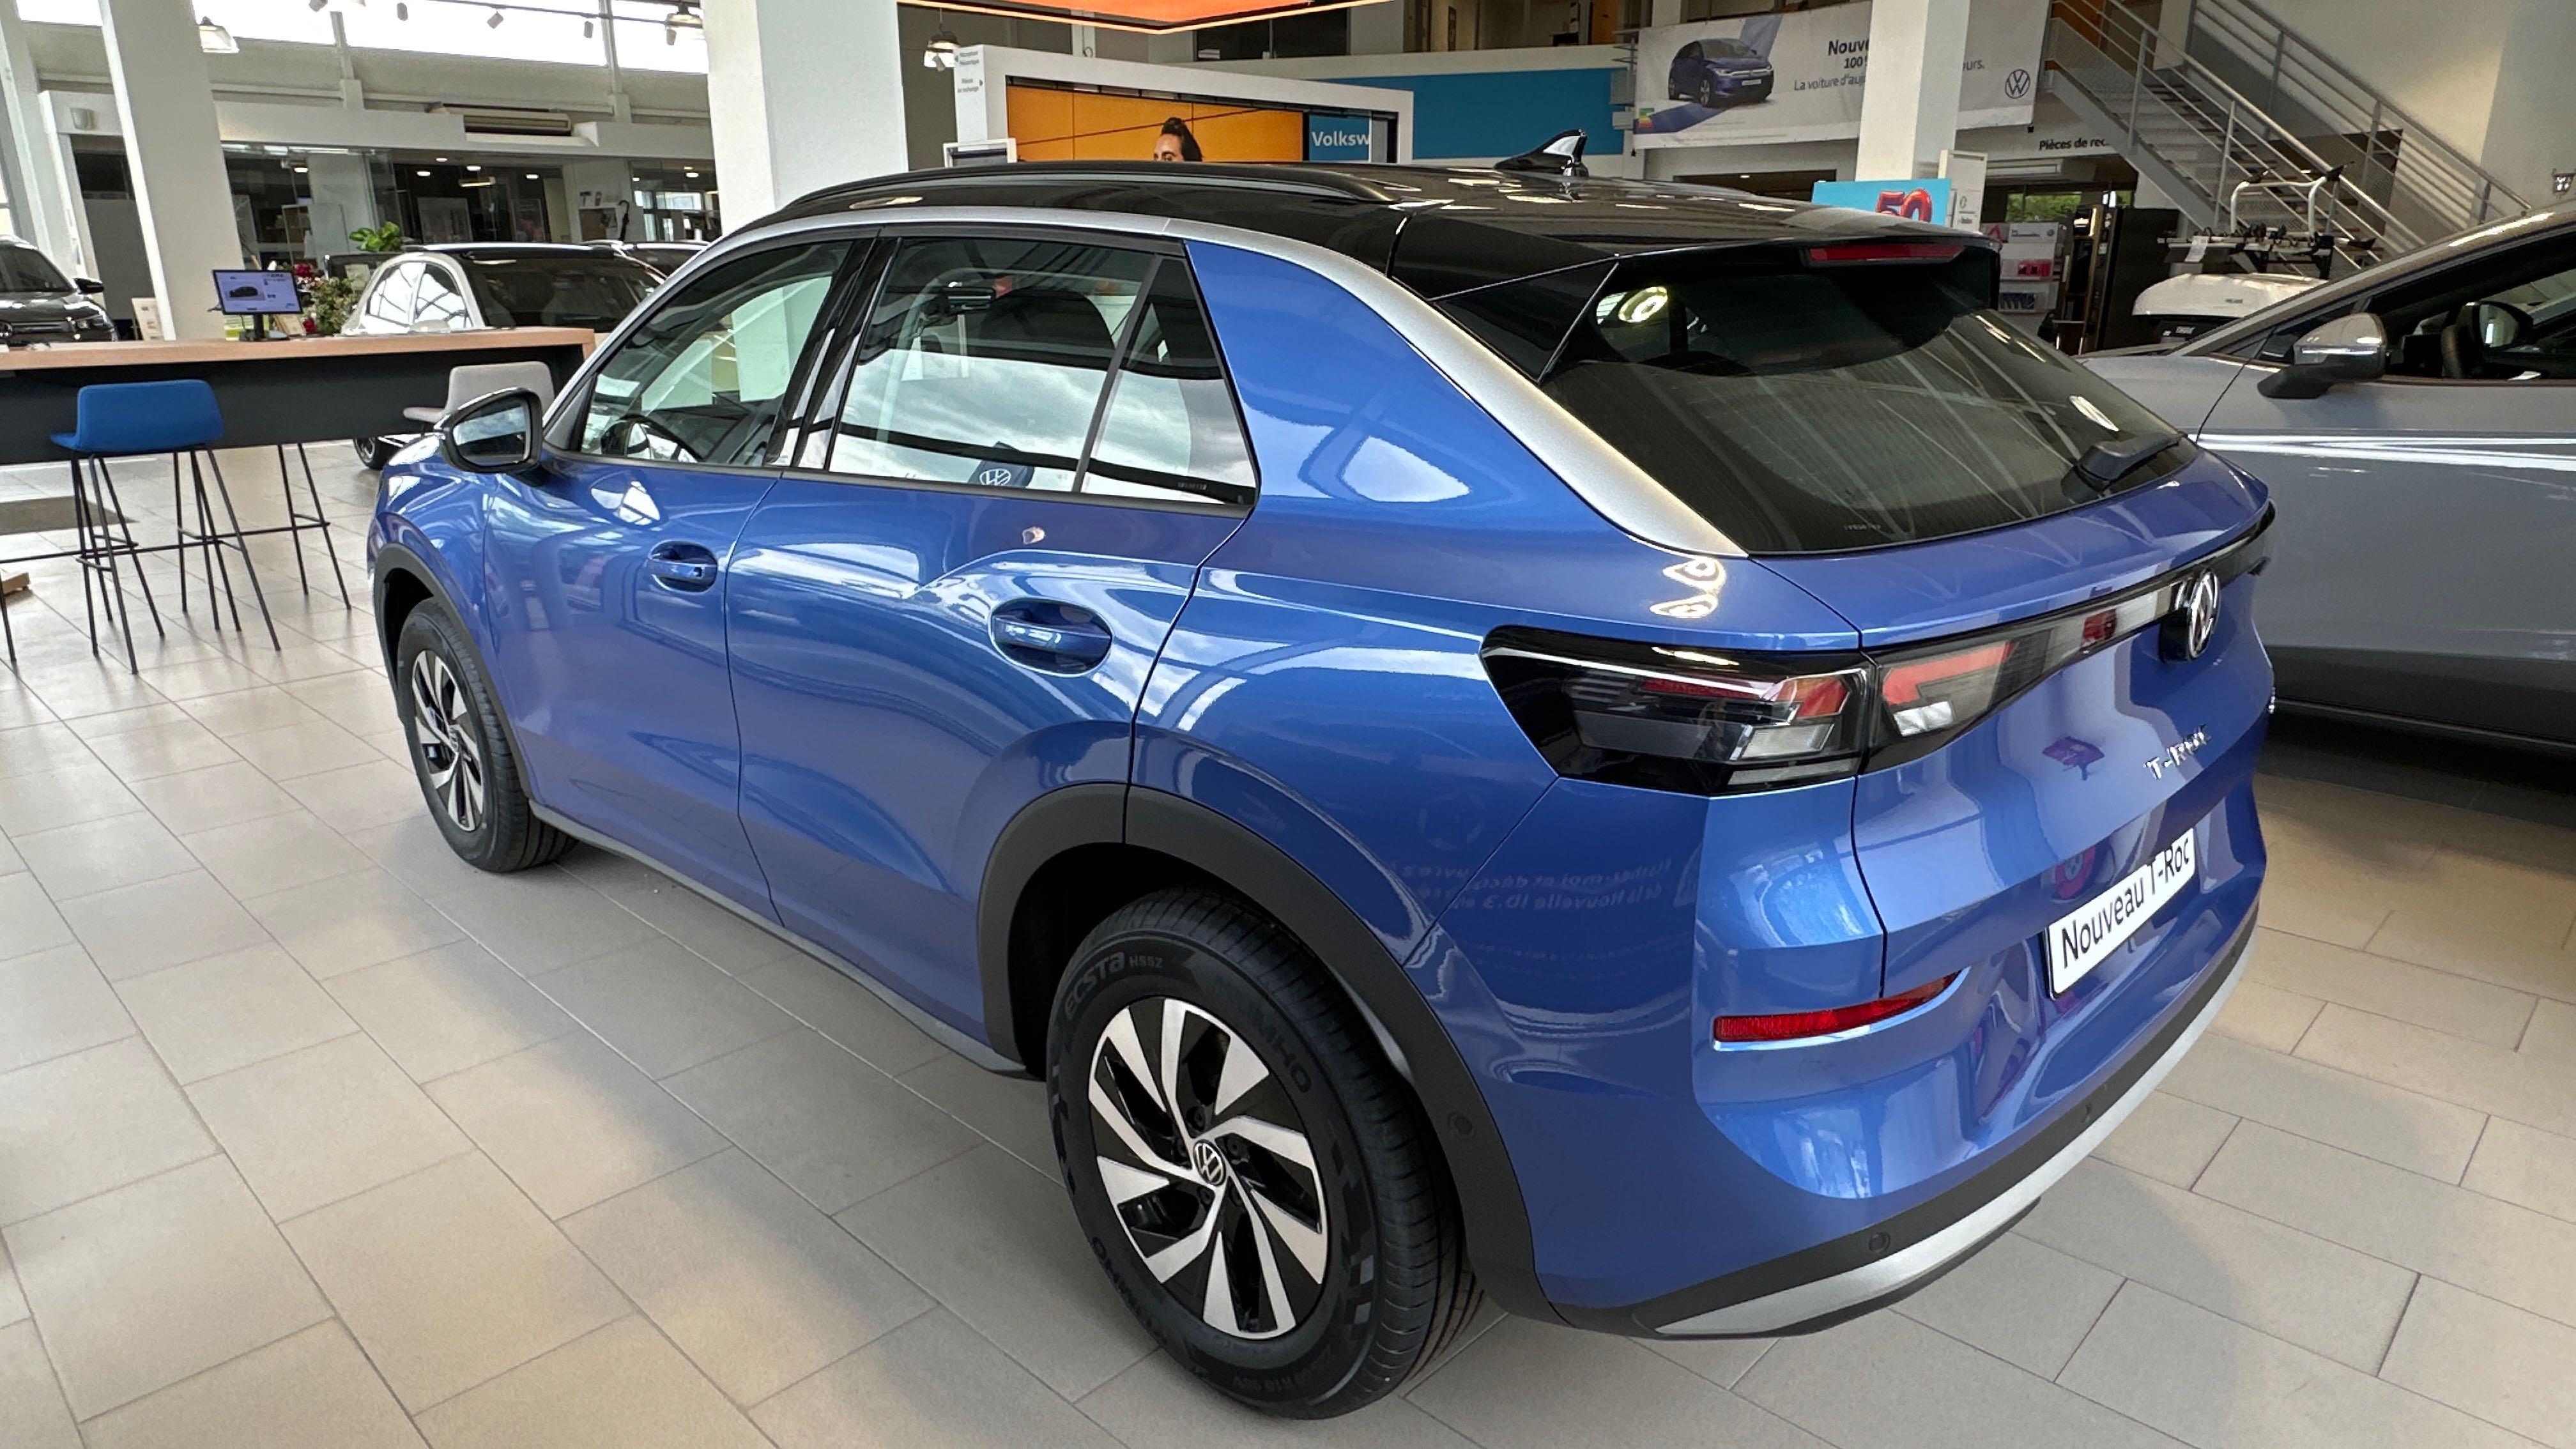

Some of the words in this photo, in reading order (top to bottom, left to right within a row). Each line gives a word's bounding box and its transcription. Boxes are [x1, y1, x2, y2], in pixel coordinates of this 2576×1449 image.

[1794, 80, 1805, 91] La
[1808, 77, 1839, 89] voiture
[2039, 139, 2071, 151] Pièces
[2074, 137, 2088, 148] de
[2089, 138, 2106, 147] rec
[2062, 877, 2145, 969] Nouveau
[2148, 837, 2190, 896] T-Roc
